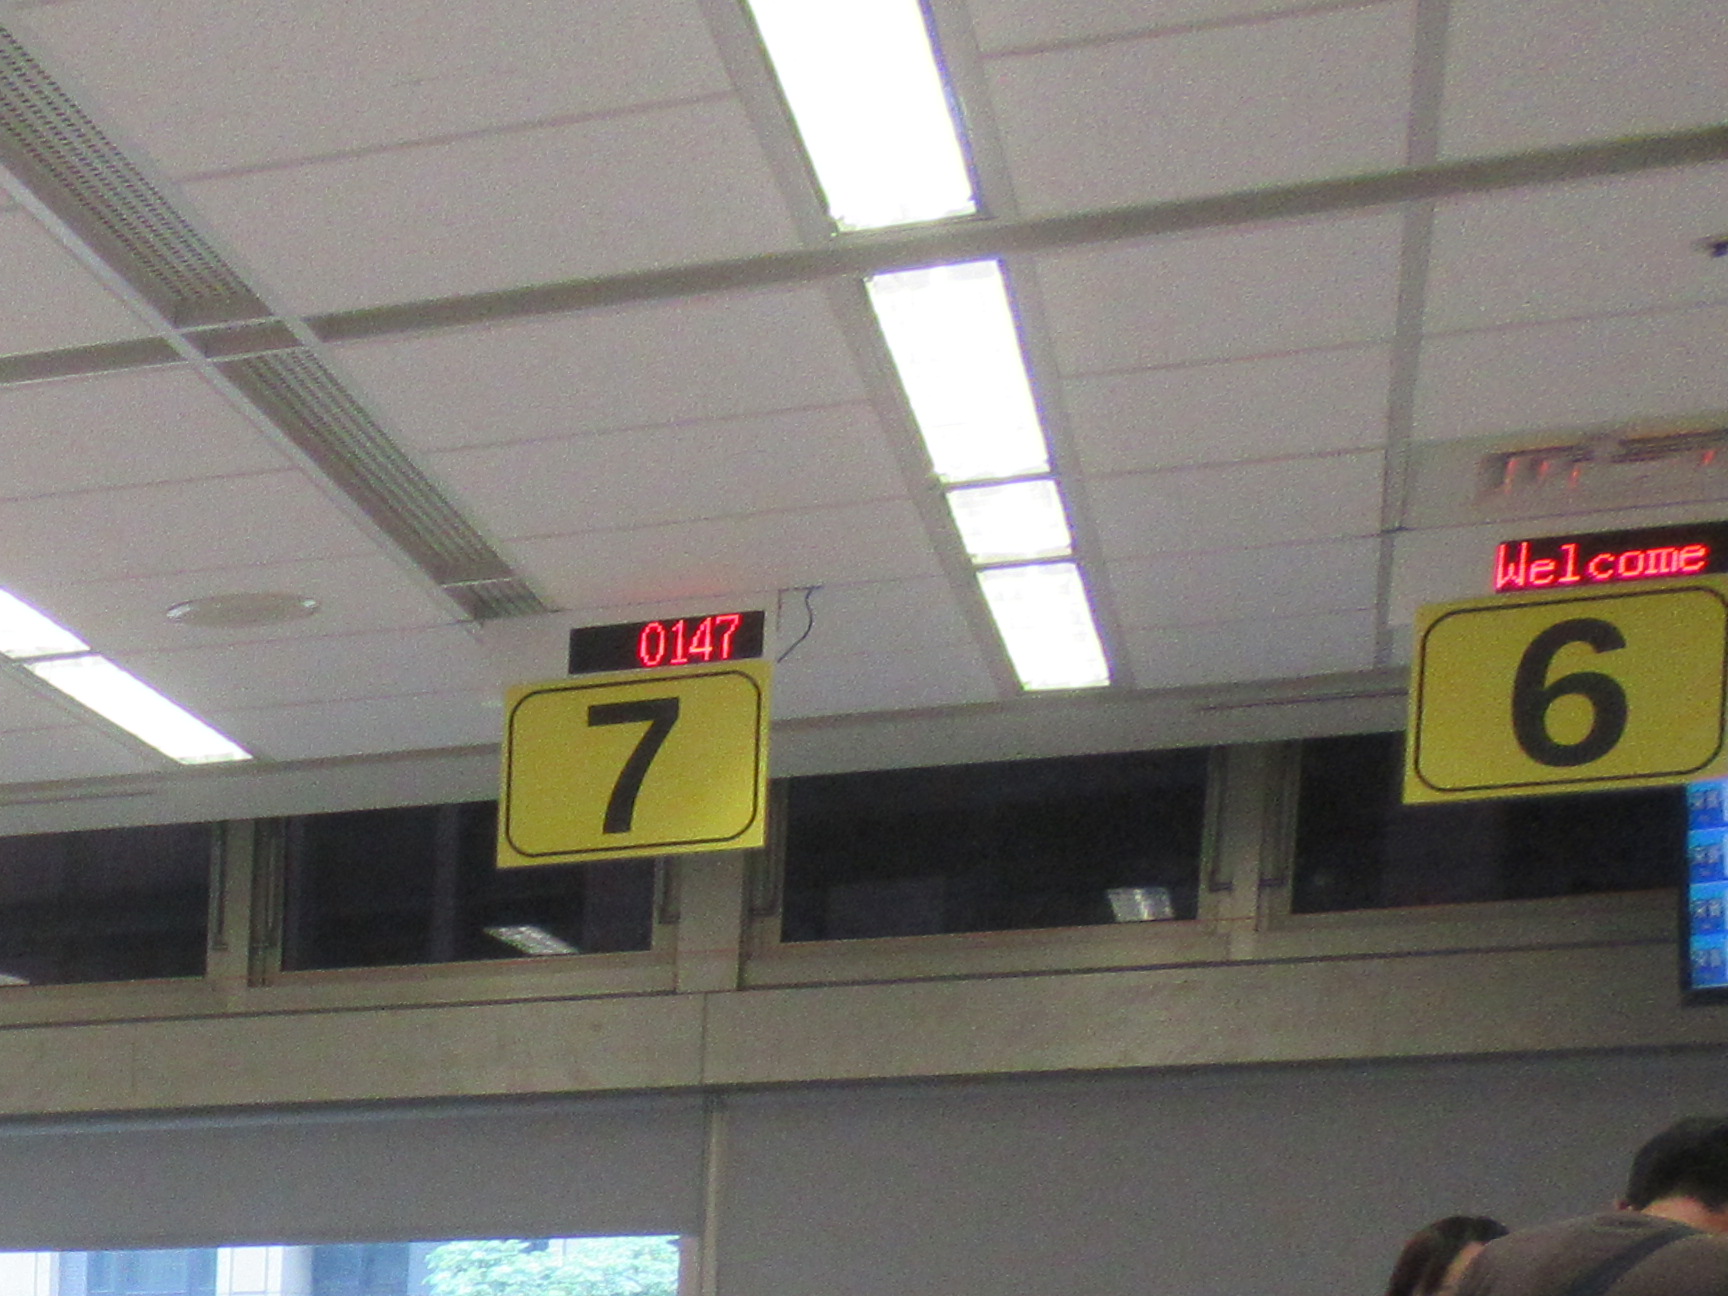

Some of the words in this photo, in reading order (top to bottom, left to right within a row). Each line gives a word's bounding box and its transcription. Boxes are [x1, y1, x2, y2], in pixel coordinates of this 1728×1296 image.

[1493, 542, 1709, 590] Welcome
[637, 613, 741, 668] 0147
[1511, 617, 1628, 767] 6
[585, 697, 681, 835] 7
